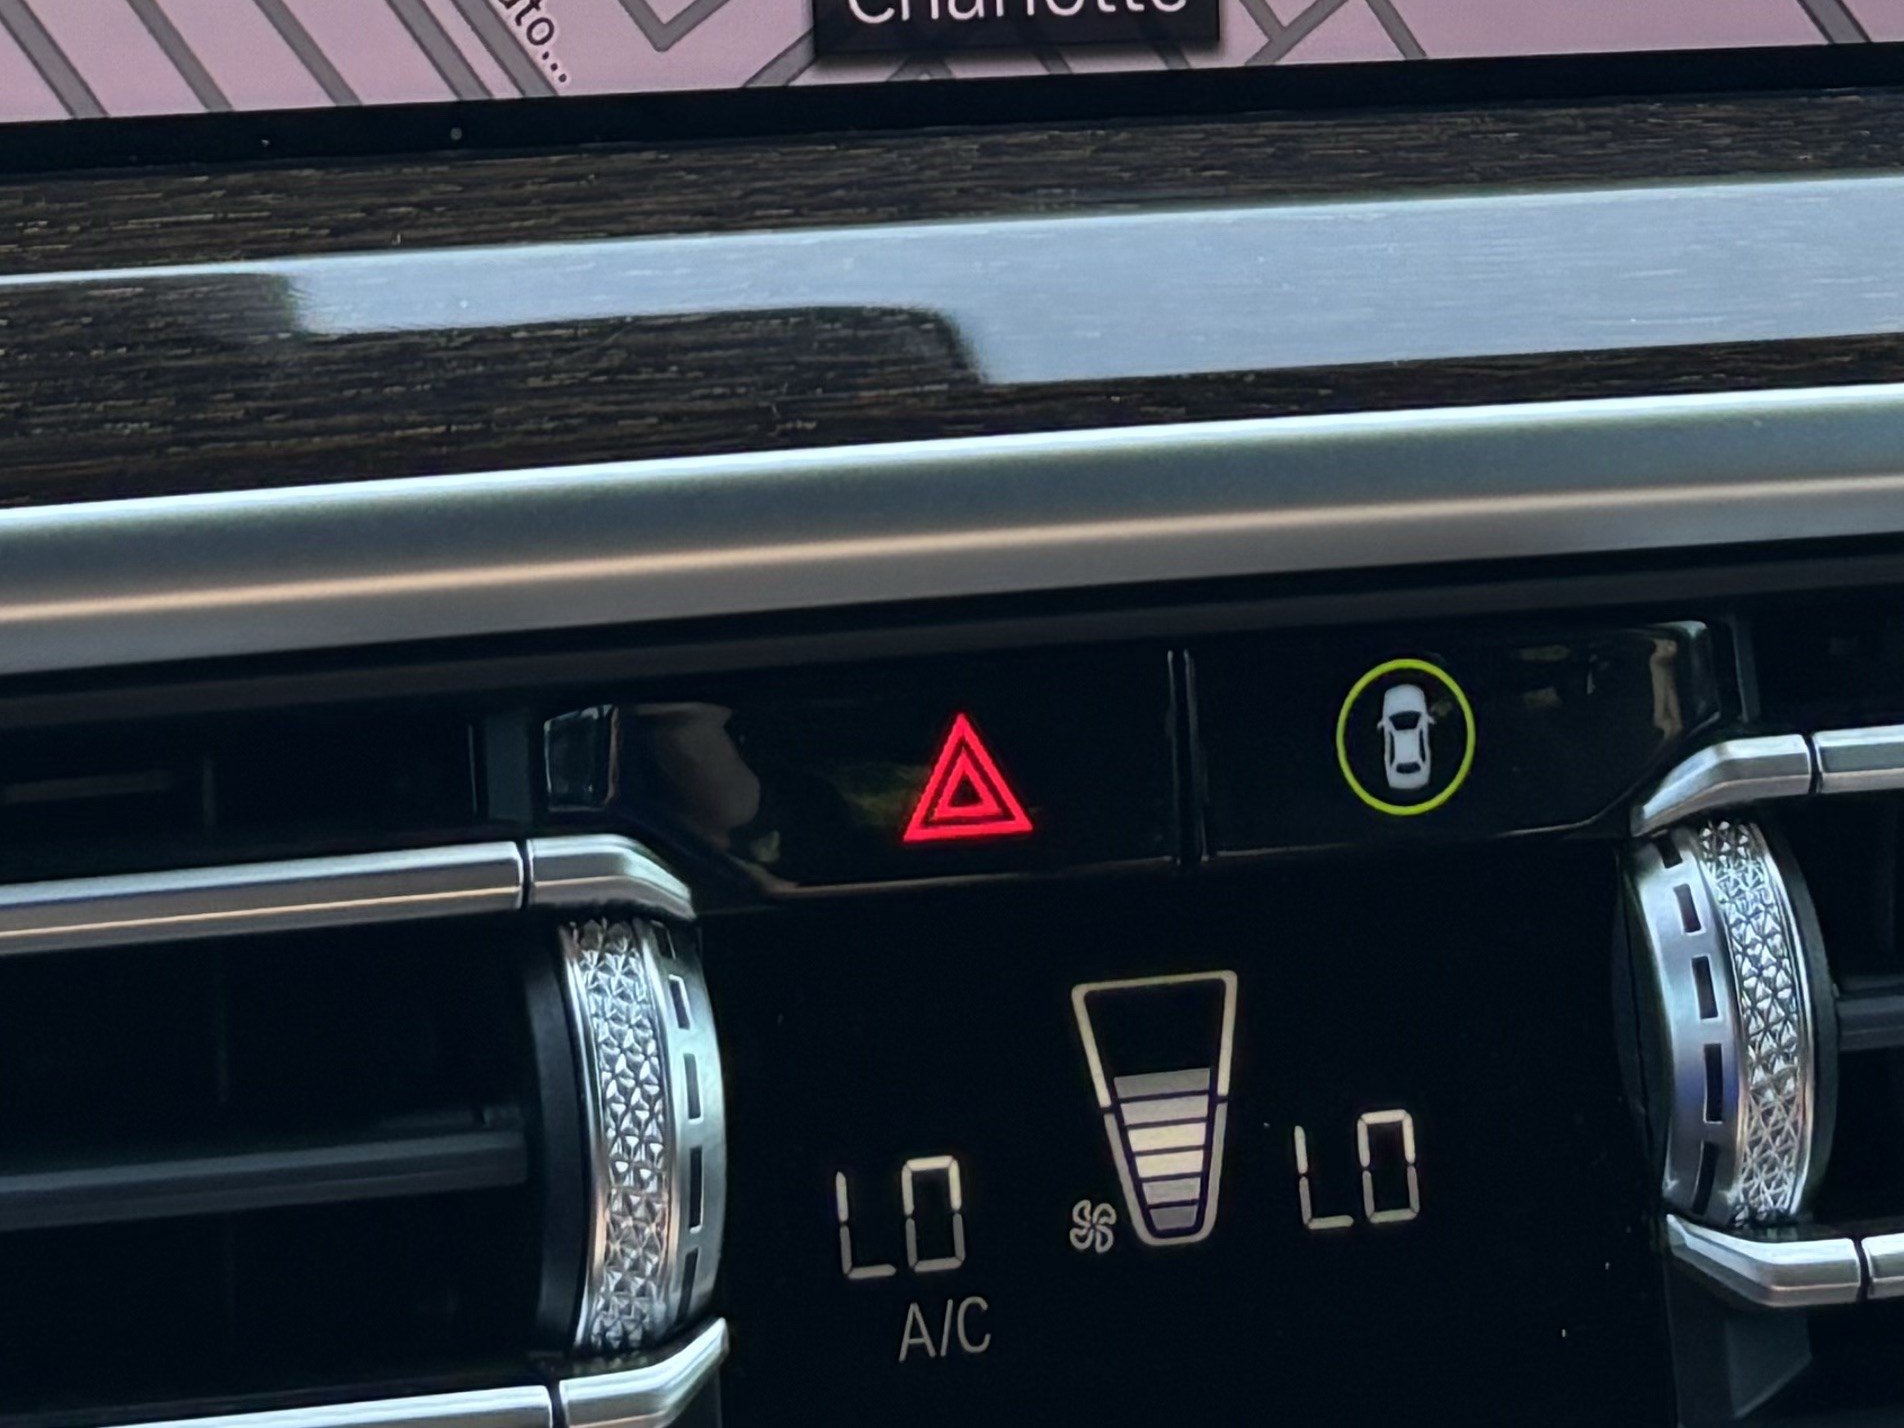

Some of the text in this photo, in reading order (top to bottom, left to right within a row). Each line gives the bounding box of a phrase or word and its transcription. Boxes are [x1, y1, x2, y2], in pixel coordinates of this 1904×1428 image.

[835, 1154, 966, 1280] LO
[1294, 1108, 1420, 1230] LO
[898, 1296, 992, 1363] A/C
